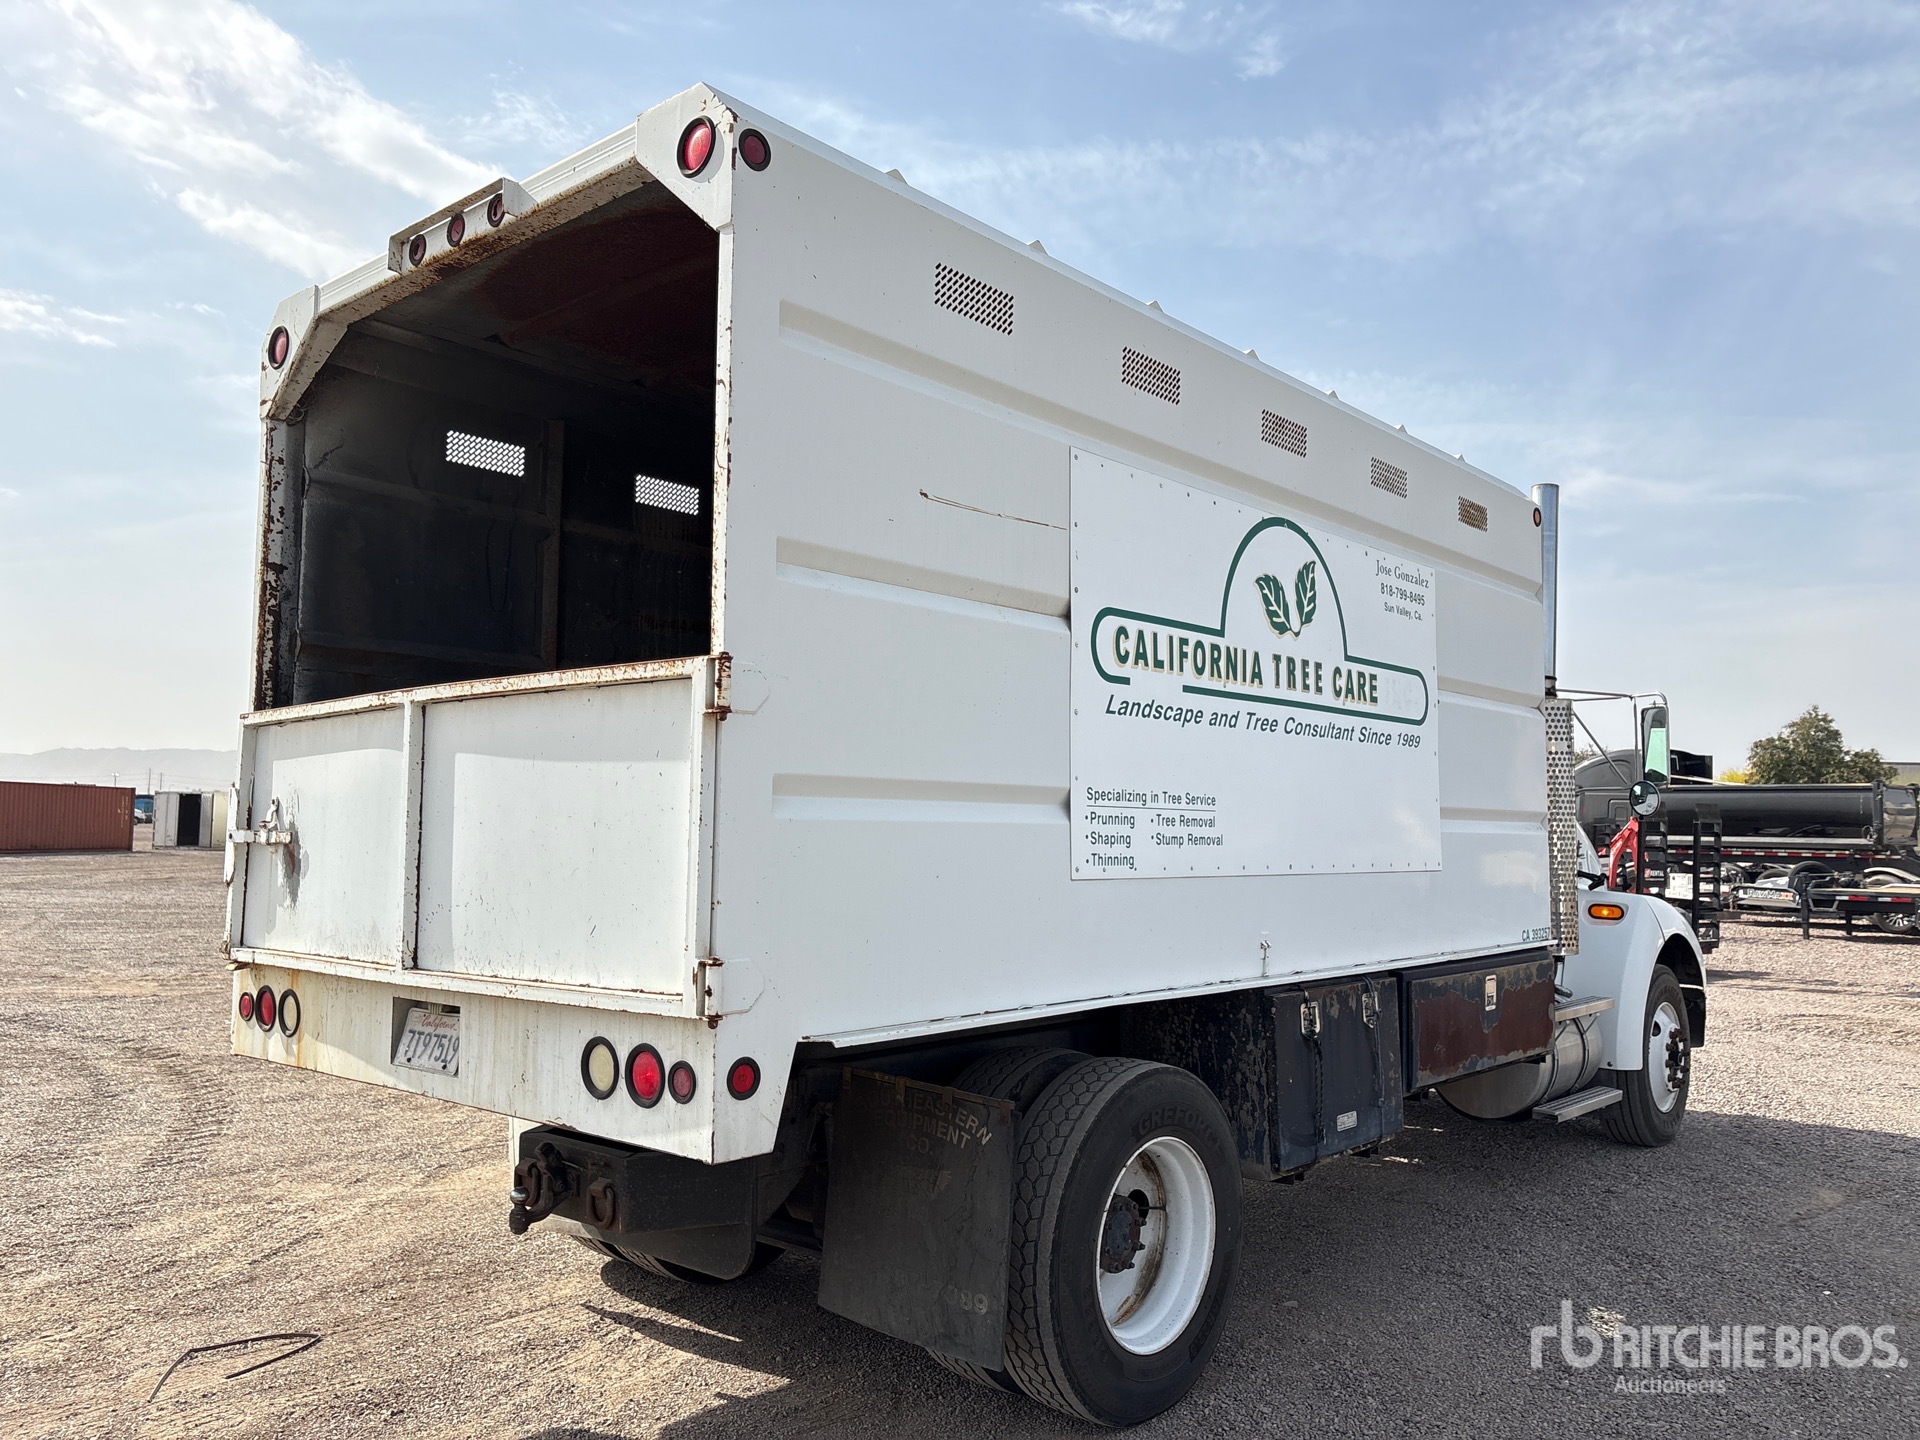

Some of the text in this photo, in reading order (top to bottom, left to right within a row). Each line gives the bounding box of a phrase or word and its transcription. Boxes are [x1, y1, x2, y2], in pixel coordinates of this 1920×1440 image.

[1376, 560, 1429, 588] Jose Gonzalez
[1380, 582, 1425, 606] 818-799-8495
[1384, 601, 1395, 613] Sun
[1113, 624, 1263, 689] CALIFORNIA
[1272, 653, 1323, 695] TREE
[1332, 666, 1378, 706] CARE
[1105, 694, 1421, 748] Landscape and Tree Consultant Since 1989
[1086, 787, 1217, 806] Specializing in Tree Service
[1090, 811, 1135, 829] Prunning
[1156, 814, 1216, 828] Tree Removal
[1090, 831, 1131, 848] Shaping
[1156, 833, 1223, 849] Stump Removal
[1091, 853, 1135, 869] Thinning
[1522, 929, 1530, 941] CA
